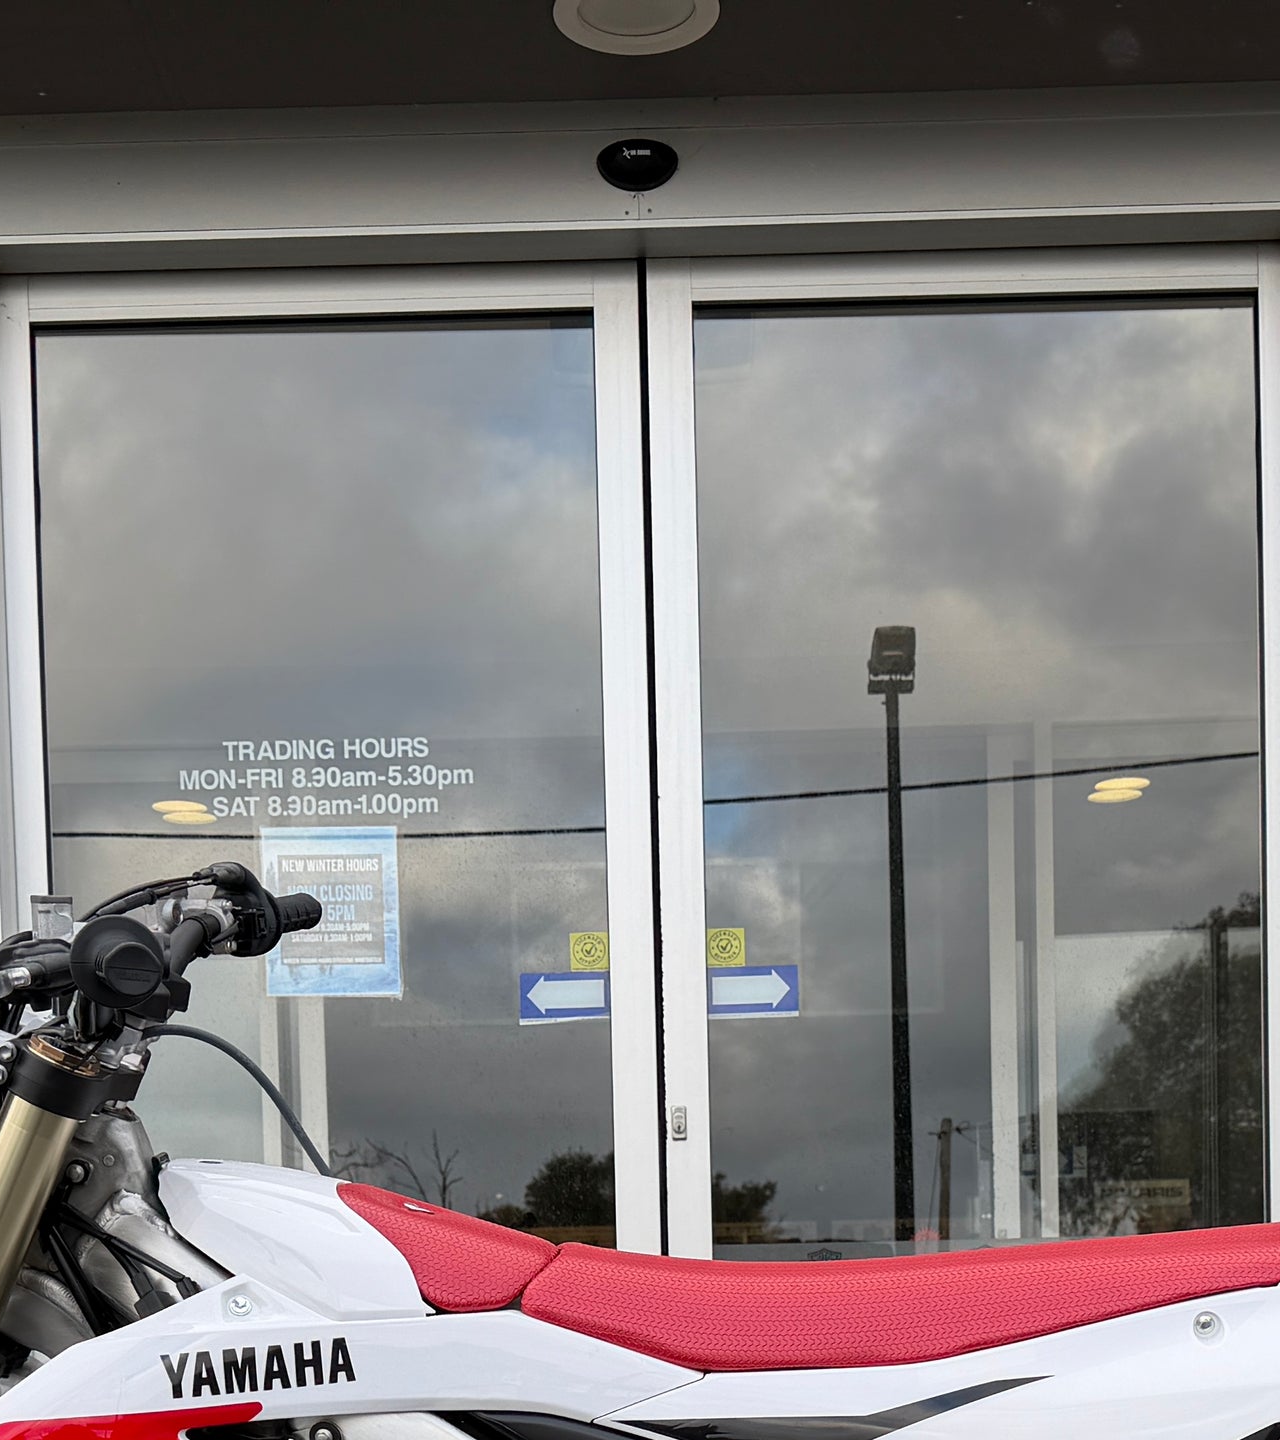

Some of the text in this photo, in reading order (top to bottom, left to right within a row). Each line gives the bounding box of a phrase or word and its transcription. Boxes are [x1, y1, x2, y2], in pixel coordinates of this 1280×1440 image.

[223, 737, 429, 761] TRADING HOURS
[179, 765, 474, 790] MON-FRI 8.30am-5.30pm
[212, 797, 260, 817] SAT
[281, 858, 378, 872] NEW WINTER HOURS
[320, 884, 373, 901] CLOSING
[327, 904, 355, 921] 5PM
[160, 1337, 356, 1399] YAMAHA
